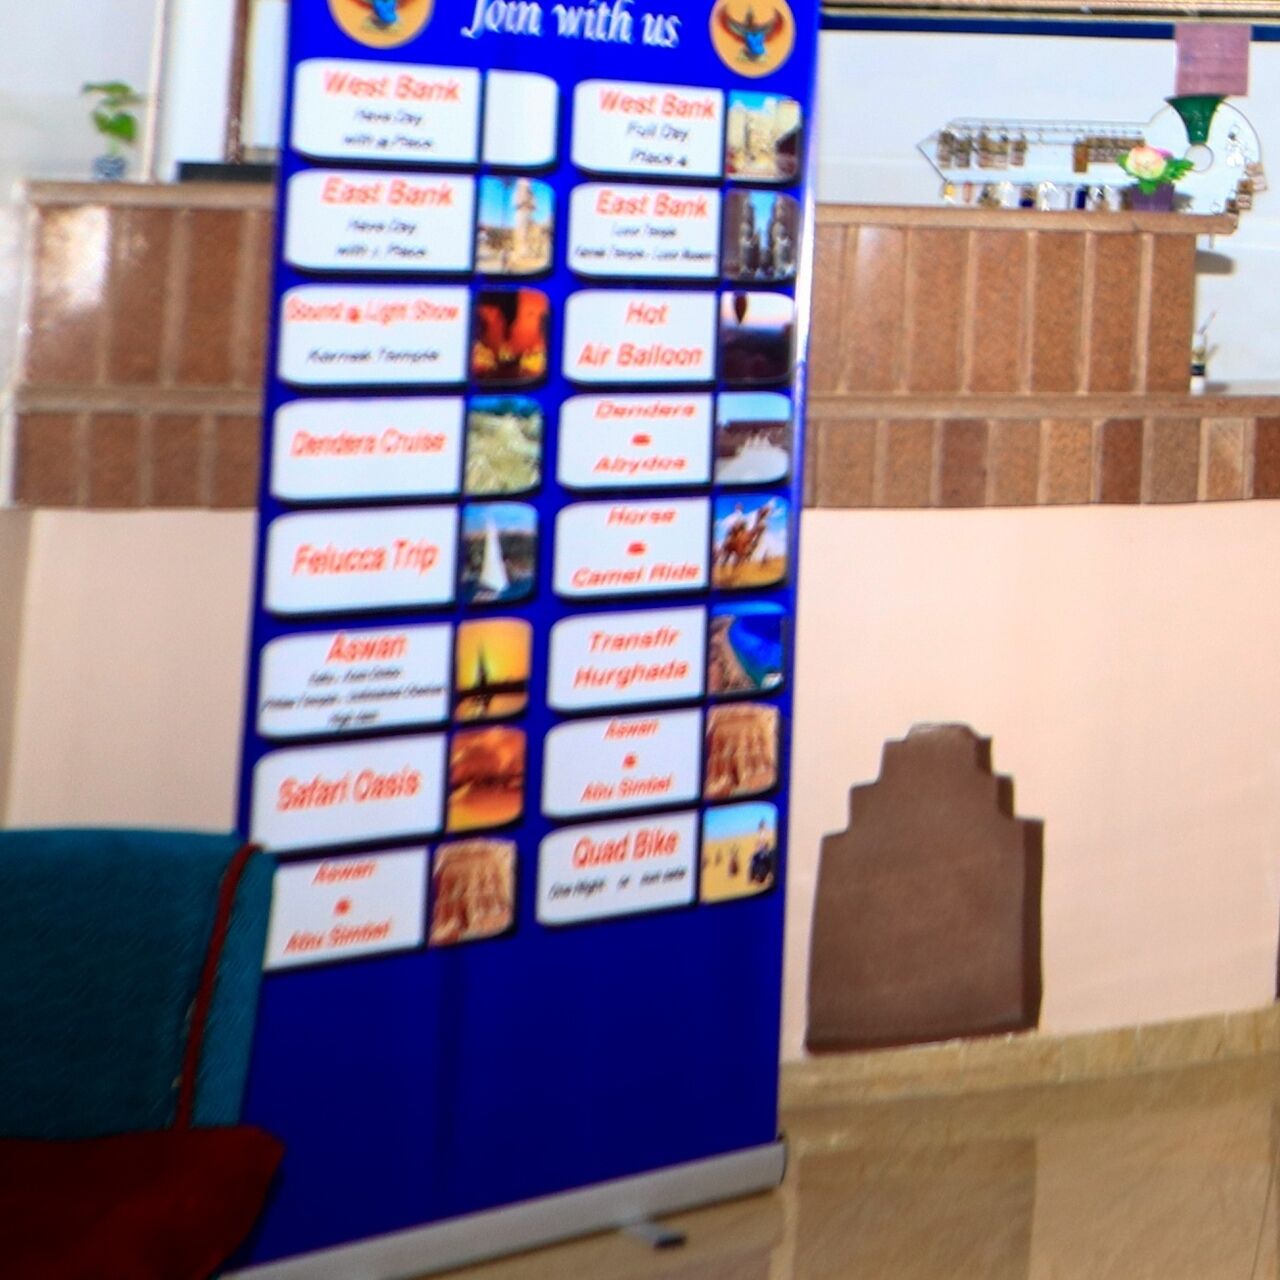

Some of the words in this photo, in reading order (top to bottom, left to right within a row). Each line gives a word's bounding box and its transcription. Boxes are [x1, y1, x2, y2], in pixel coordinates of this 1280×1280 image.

[642, 11, 682, 49] us
[324, 69, 388, 98] West
[394, 73, 461, 102] Bank
[599, 88, 656, 116] West
[661, 93, 716, 120] Bank
[321, 176, 383, 206] East
[388, 178, 454, 207] Bank
[595, 189, 649, 216] East
[654, 192, 709, 219] Bank
[626, 301, 670, 325] Hot
[578, 343, 612, 366] Air
[616, 343, 704, 366] Balloon
[380, 428, 449, 456] Cruise
[292, 542, 386, 576] Felucca
[392, 537, 440, 575] Trip
[571, 566, 644, 589] Camel
[649, 562, 701, 581] Ride
[326, 631, 408, 663] Aswan
[573, 659, 690, 692] Hurghada
[276, 773, 350, 813] Safari
[352, 764, 422, 803] Oasis
[573, 833, 629, 870] Quad
[633, 827, 680, 861] Bike
